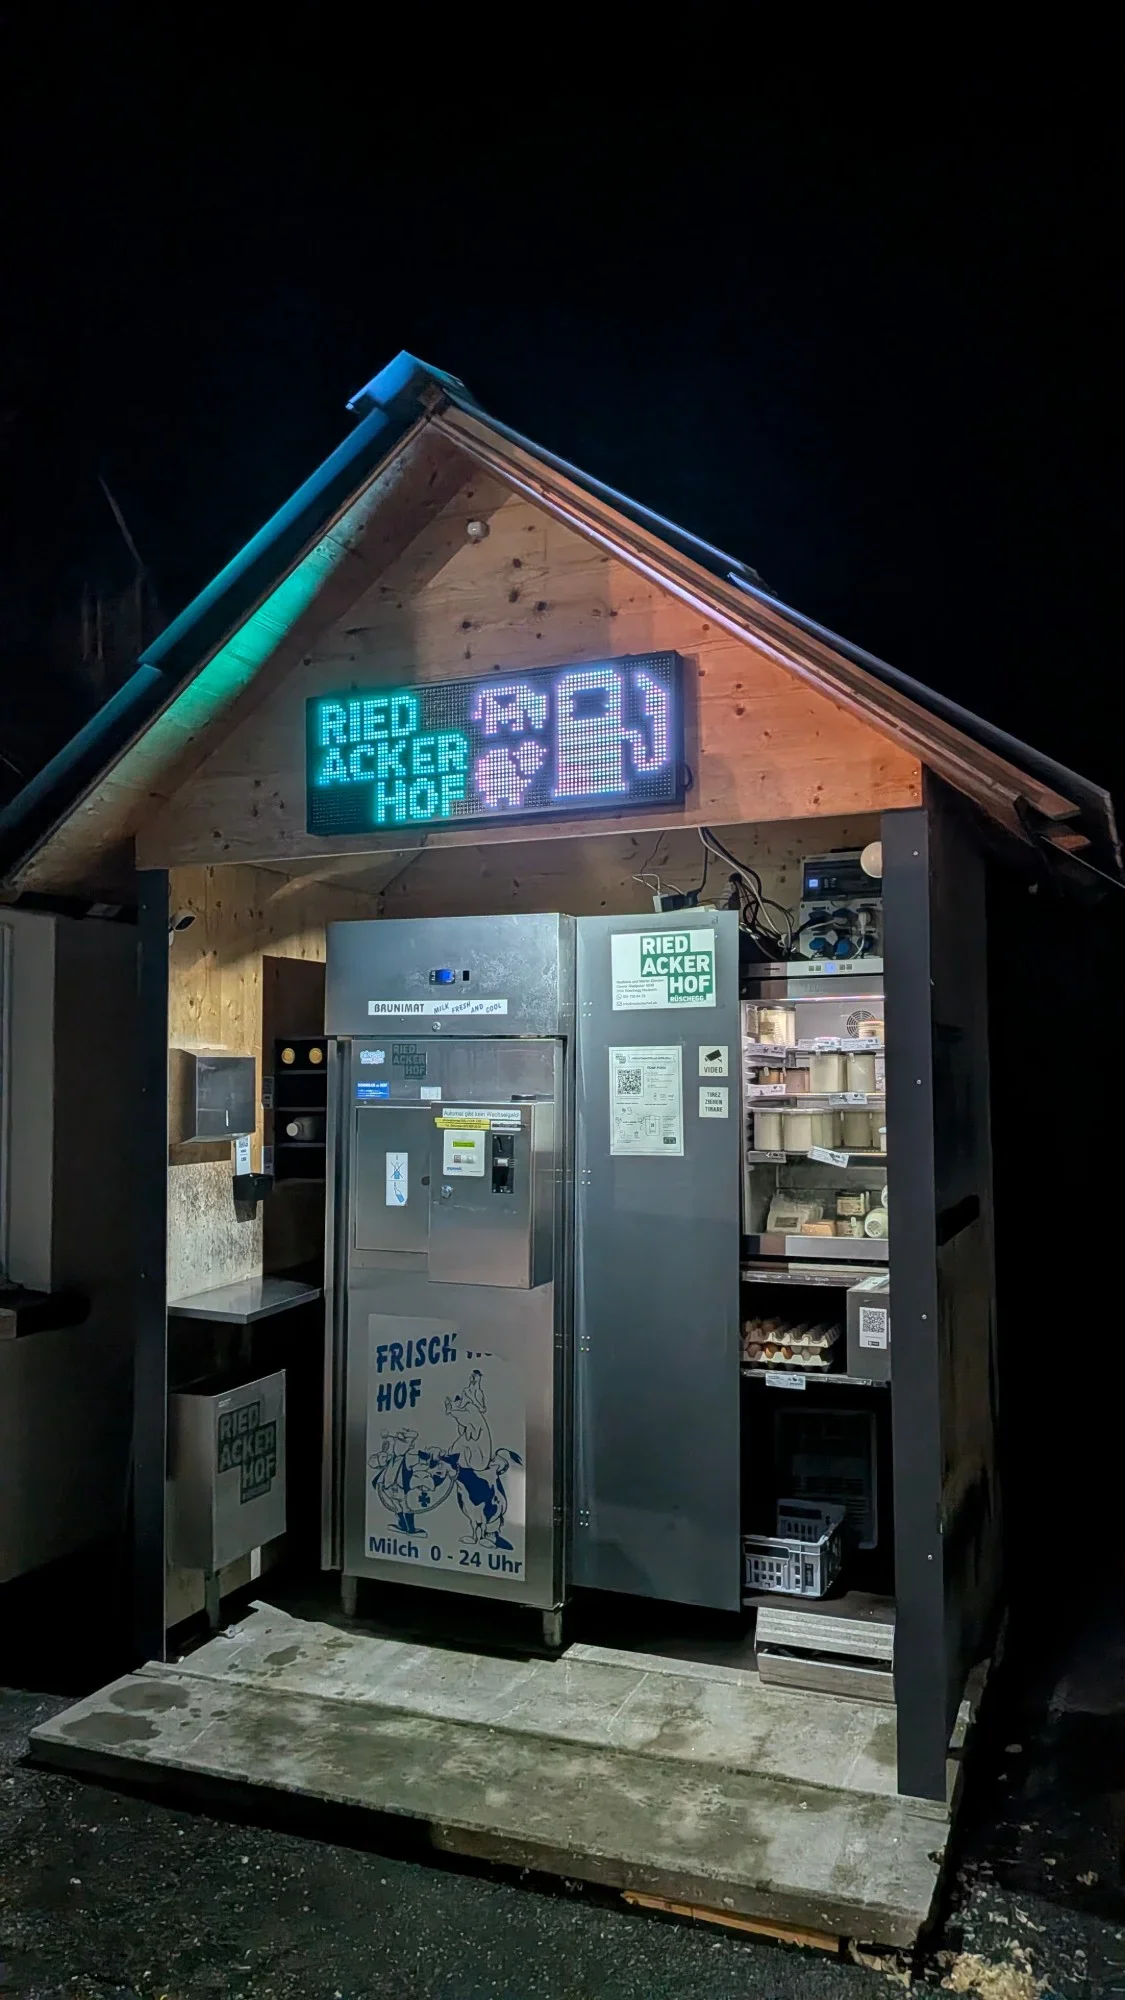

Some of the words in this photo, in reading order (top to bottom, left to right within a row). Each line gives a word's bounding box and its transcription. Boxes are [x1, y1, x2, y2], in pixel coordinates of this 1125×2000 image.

[321, 696, 418, 745] RIED
[318, 733, 469, 786] ACKER
[377, 774, 464, 822] HOF
[642, 936, 689, 955] RIED
[642, 955, 711, 976] ACKER
[670, 976, 710, 993] HOF
[374, 1003, 425, 1013] BRUNIMAT
[433, 1002, 450, 1014] MILK
[451, 1001, 471, 1014] FRESH
[471, 1003, 484, 1014] AND
[485, 1002, 502, 1014] COOL
[670, 994, 705, 1003] RÜSCHEGG
[393, 1045, 416, 1054] RIED
[393, 1054, 425, 1065] ACKER
[405, 1065, 425, 1075] HOF
[704, 1066, 723, 1074] VIDEO
[464, 1110, 474, 1118] gibt
[376, 1333, 458, 1373] FRISCH
[377, 1379, 422, 1412] HOF
[220, 1405, 258, 1440] RIED
[220, 1427, 274, 1471] ACKER
[242, 1455, 275, 1489] HOF
[368, 1536, 419, 1559] Milch
[430, 1545, 442, 1562] 0
[459, 1549, 482, 1568] 24
[488, 1554, 523, 1575] Uhr
